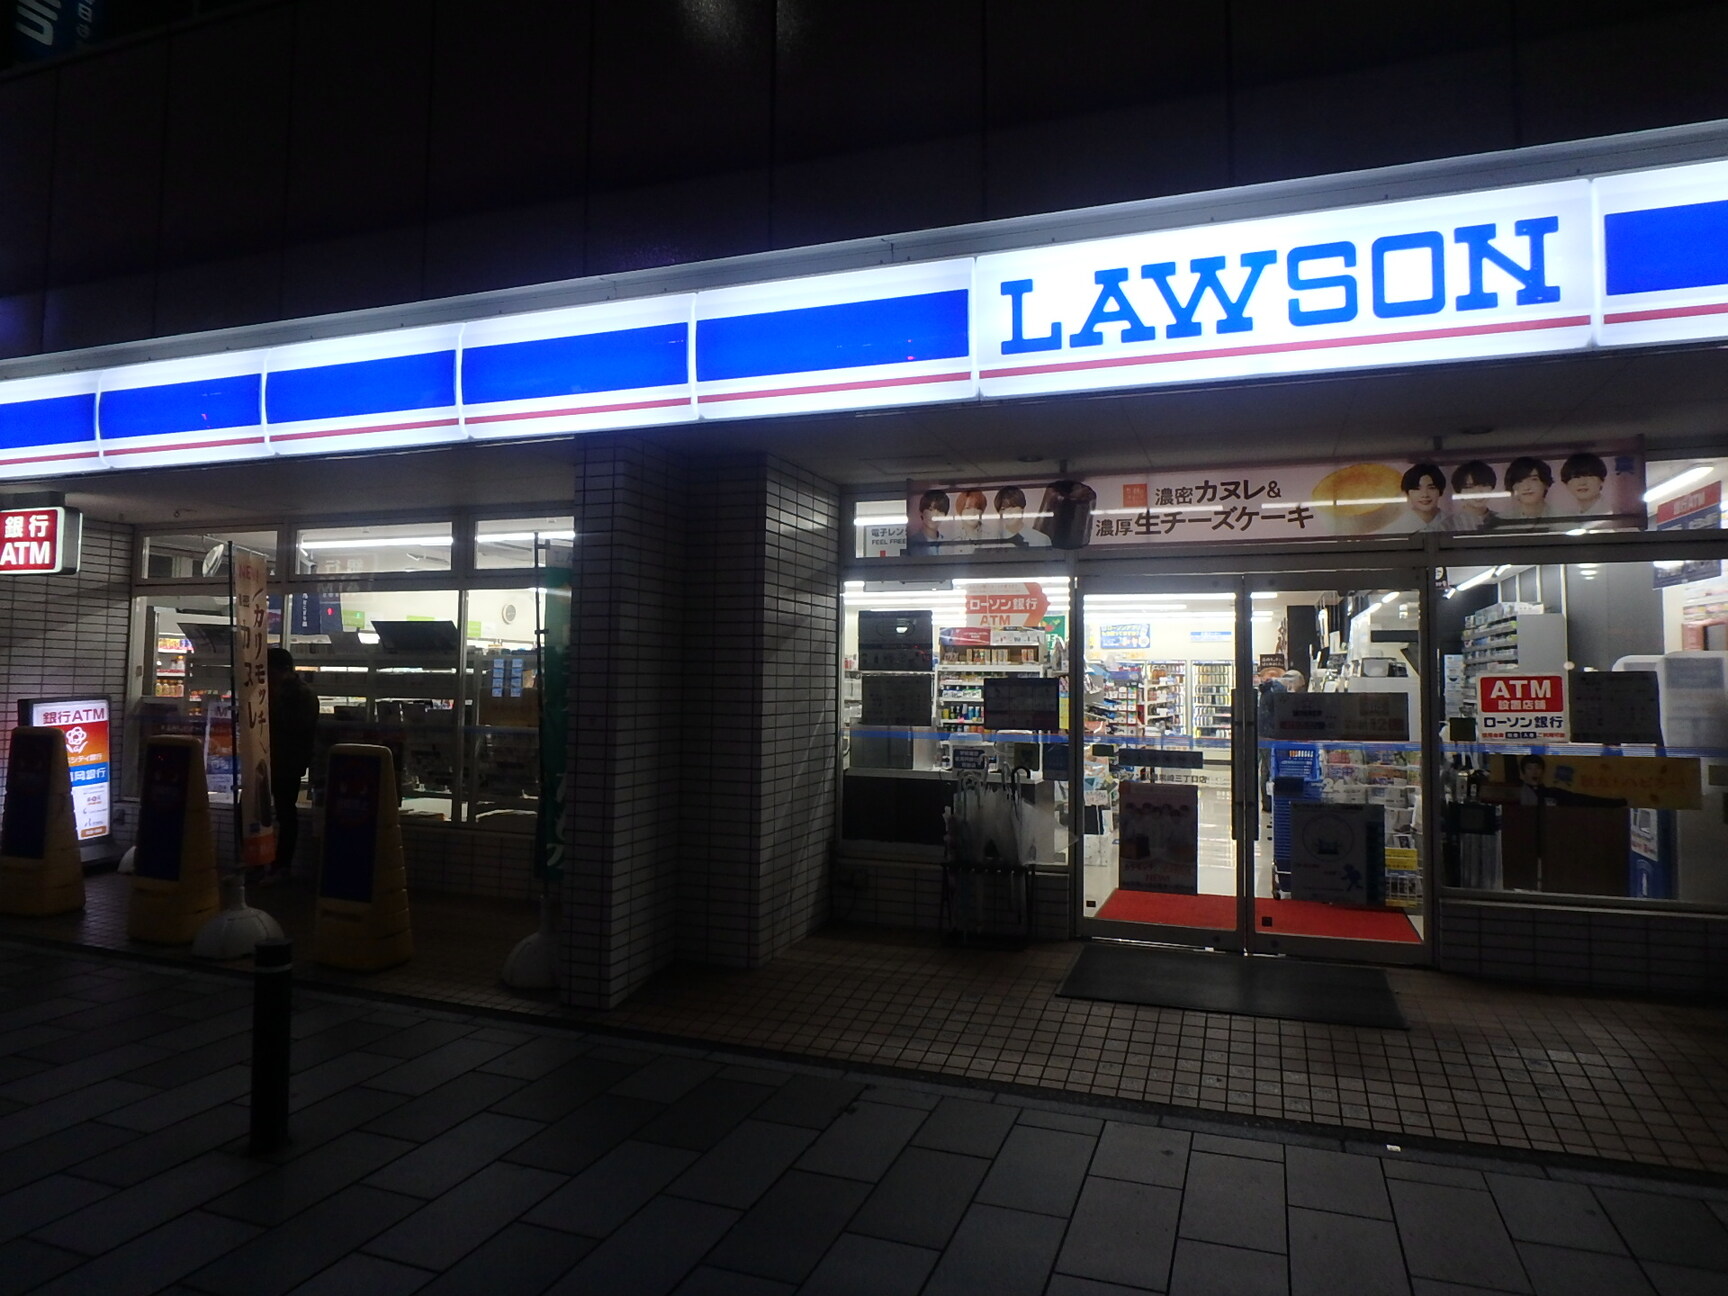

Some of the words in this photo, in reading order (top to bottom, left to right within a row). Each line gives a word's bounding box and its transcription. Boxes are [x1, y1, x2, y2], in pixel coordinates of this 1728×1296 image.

[1000, 215, 1560, 355] LAWSON
[1155, 479, 1282, 506] 濃密カヌレ&
[4, 515, 49, 538] 銀行
[1095, 504, 1315, 538] 濃厚生チーズケーキ
[871, 527, 907, 537] 電子レン
[0, 541, 51, 565] ATM
[969, 597, 1038, 610] ローソン銀行
[979, 615, 1011, 625] ATM
[1490, 679, 1552, 699] ATM
[42, 707, 105, 725] 銀行ATM
[1484, 716, 1564, 729] ローソン銀行
